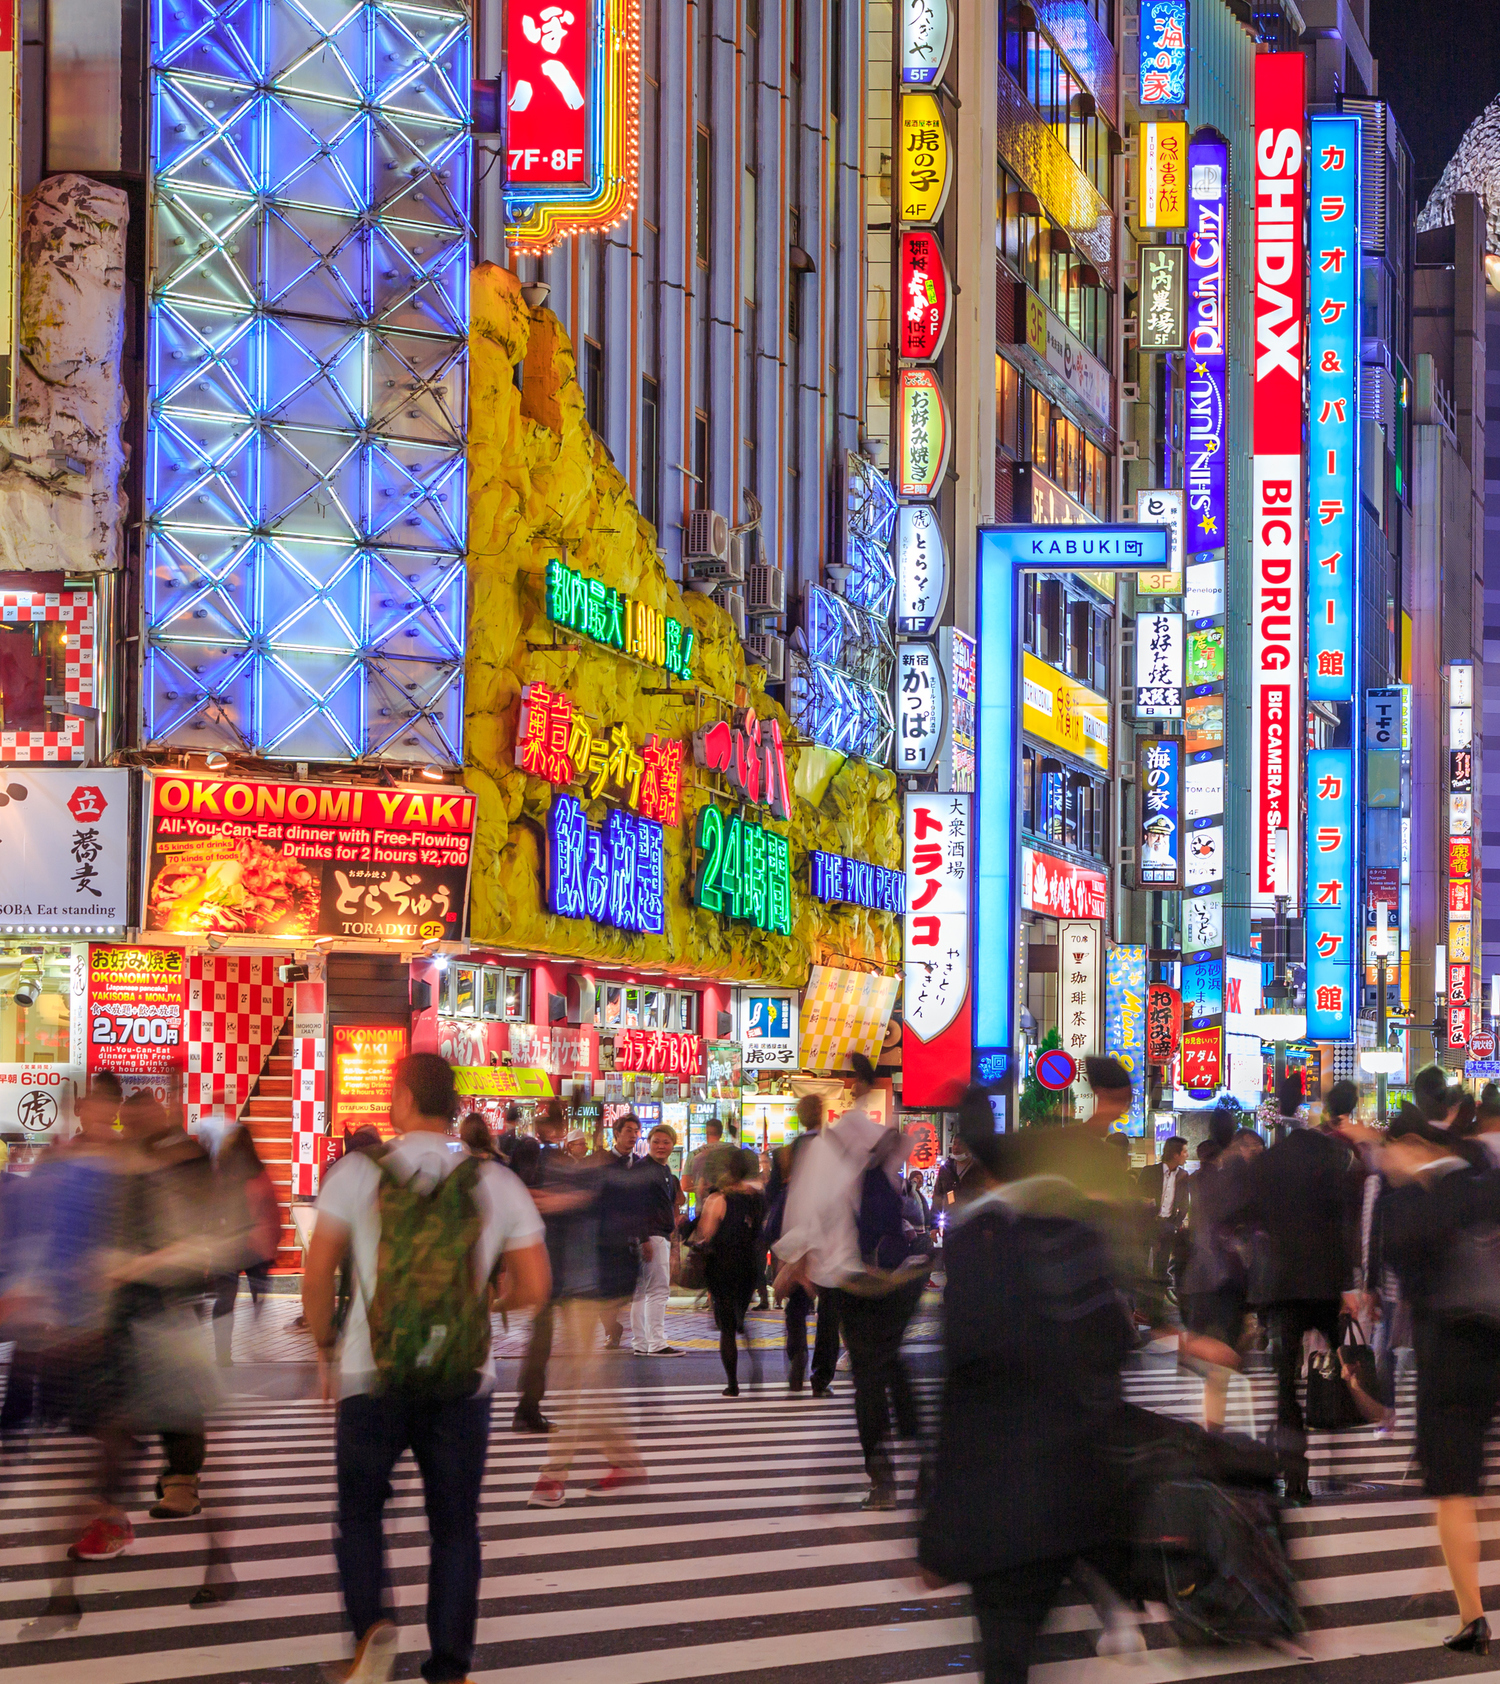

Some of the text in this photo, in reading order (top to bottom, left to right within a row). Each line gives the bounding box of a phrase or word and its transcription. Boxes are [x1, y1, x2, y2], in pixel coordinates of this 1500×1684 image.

[1143, 16, 1184, 103] 海の家
[910, 69, 929, 80] 5F
[907, 129, 940, 192] 虎の子
[905, 204, 927, 216] 4F
[1256, 128, 1302, 382] SHIDAX
[1148, 251, 1176, 333] 山内農場
[930, 308, 939, 336] 3F
[1030, 302, 1043, 346] 3F
[1154, 333, 1169, 345] 5F
[909, 390, 930, 482] お好み焼き
[1190, 380, 1220, 511] SHINJUKU
[903, 484, 928, 495] 2階
[1150, 574, 1172, 589] 3F
[1260, 480, 1292, 671] BIC DRUG
[1187, 586, 1223, 595] Penelope
[905, 619, 927, 632] 1F
[903, 654, 929, 666] 新宿
[1150, 615, 1172, 685] お好み焼
[902, 668, 930, 739] かっぱ
[1139, 687, 1180, 706] 大阪家
[904, 748, 926, 762] B1
[1267, 690, 1283, 799] BIC CAMERA
[705, 707, 792, 823] つぼ八
[1146, 746, 1171, 811] 海の家
[159, 779, 473, 829] OKONOMI YAKI
[159, 818, 469, 850] All-You-Can-Eat dinner with Free-Flowing
[172, 840, 233, 851] kinds drinks
[946, 798, 967, 880] 大衆酒場
[70, 828, 103, 897] 蕎麦
[181, 852, 239, 863] kinds foods
[283, 843, 468, 866] Drinks for hours ¥2,700
[549, 793, 665, 935] 飲み放題
[696, 780, 791, 936] 24時間
[1451, 843, 1470, 873] 麻雀
[348, 869, 387, 880] お好み焼き
[815, 851, 843, 900] THE
[911, 807, 943, 947] トラノコ
[1316, 774, 1343, 1013] カラオケ館
[37, 904, 116, 918] Eat standing
[342, 920, 442, 938] TORADYU 2F
[92, 950, 182, 973] お好み焼き
[1109, 948, 1143, 961] パスタ
[92, 972, 182, 985] OKONOMI YAKI
[936, 948, 960, 1007] やきとり
[1194, 964, 1208, 1015] あります
[1208, 964, 1221, 990] 砂浜
[92, 991, 182, 1003] YAKISOBA MONJYA
[92, 1017, 179, 1046] 2,700円
[1121, 989, 1143, 1050] Miami
[1149, 990, 1173, 1057] お好み焼
[100, 1046, 170, 1054] All-You-Can-Eat
[336, 1029, 403, 1043] OKONOMI
[353, 1043, 388, 1056] YAKI
[1472, 1040, 1493, 1050] 消火栓
[102, 1060, 136, 1068] Flowing
[622, 1029, 701, 1075] カラオケBOX
[745, 1049, 795, 1064] 虎の子
[1185, 1050, 1217, 1063] アダム
[1190, 1074, 1212, 1086] イヴ
